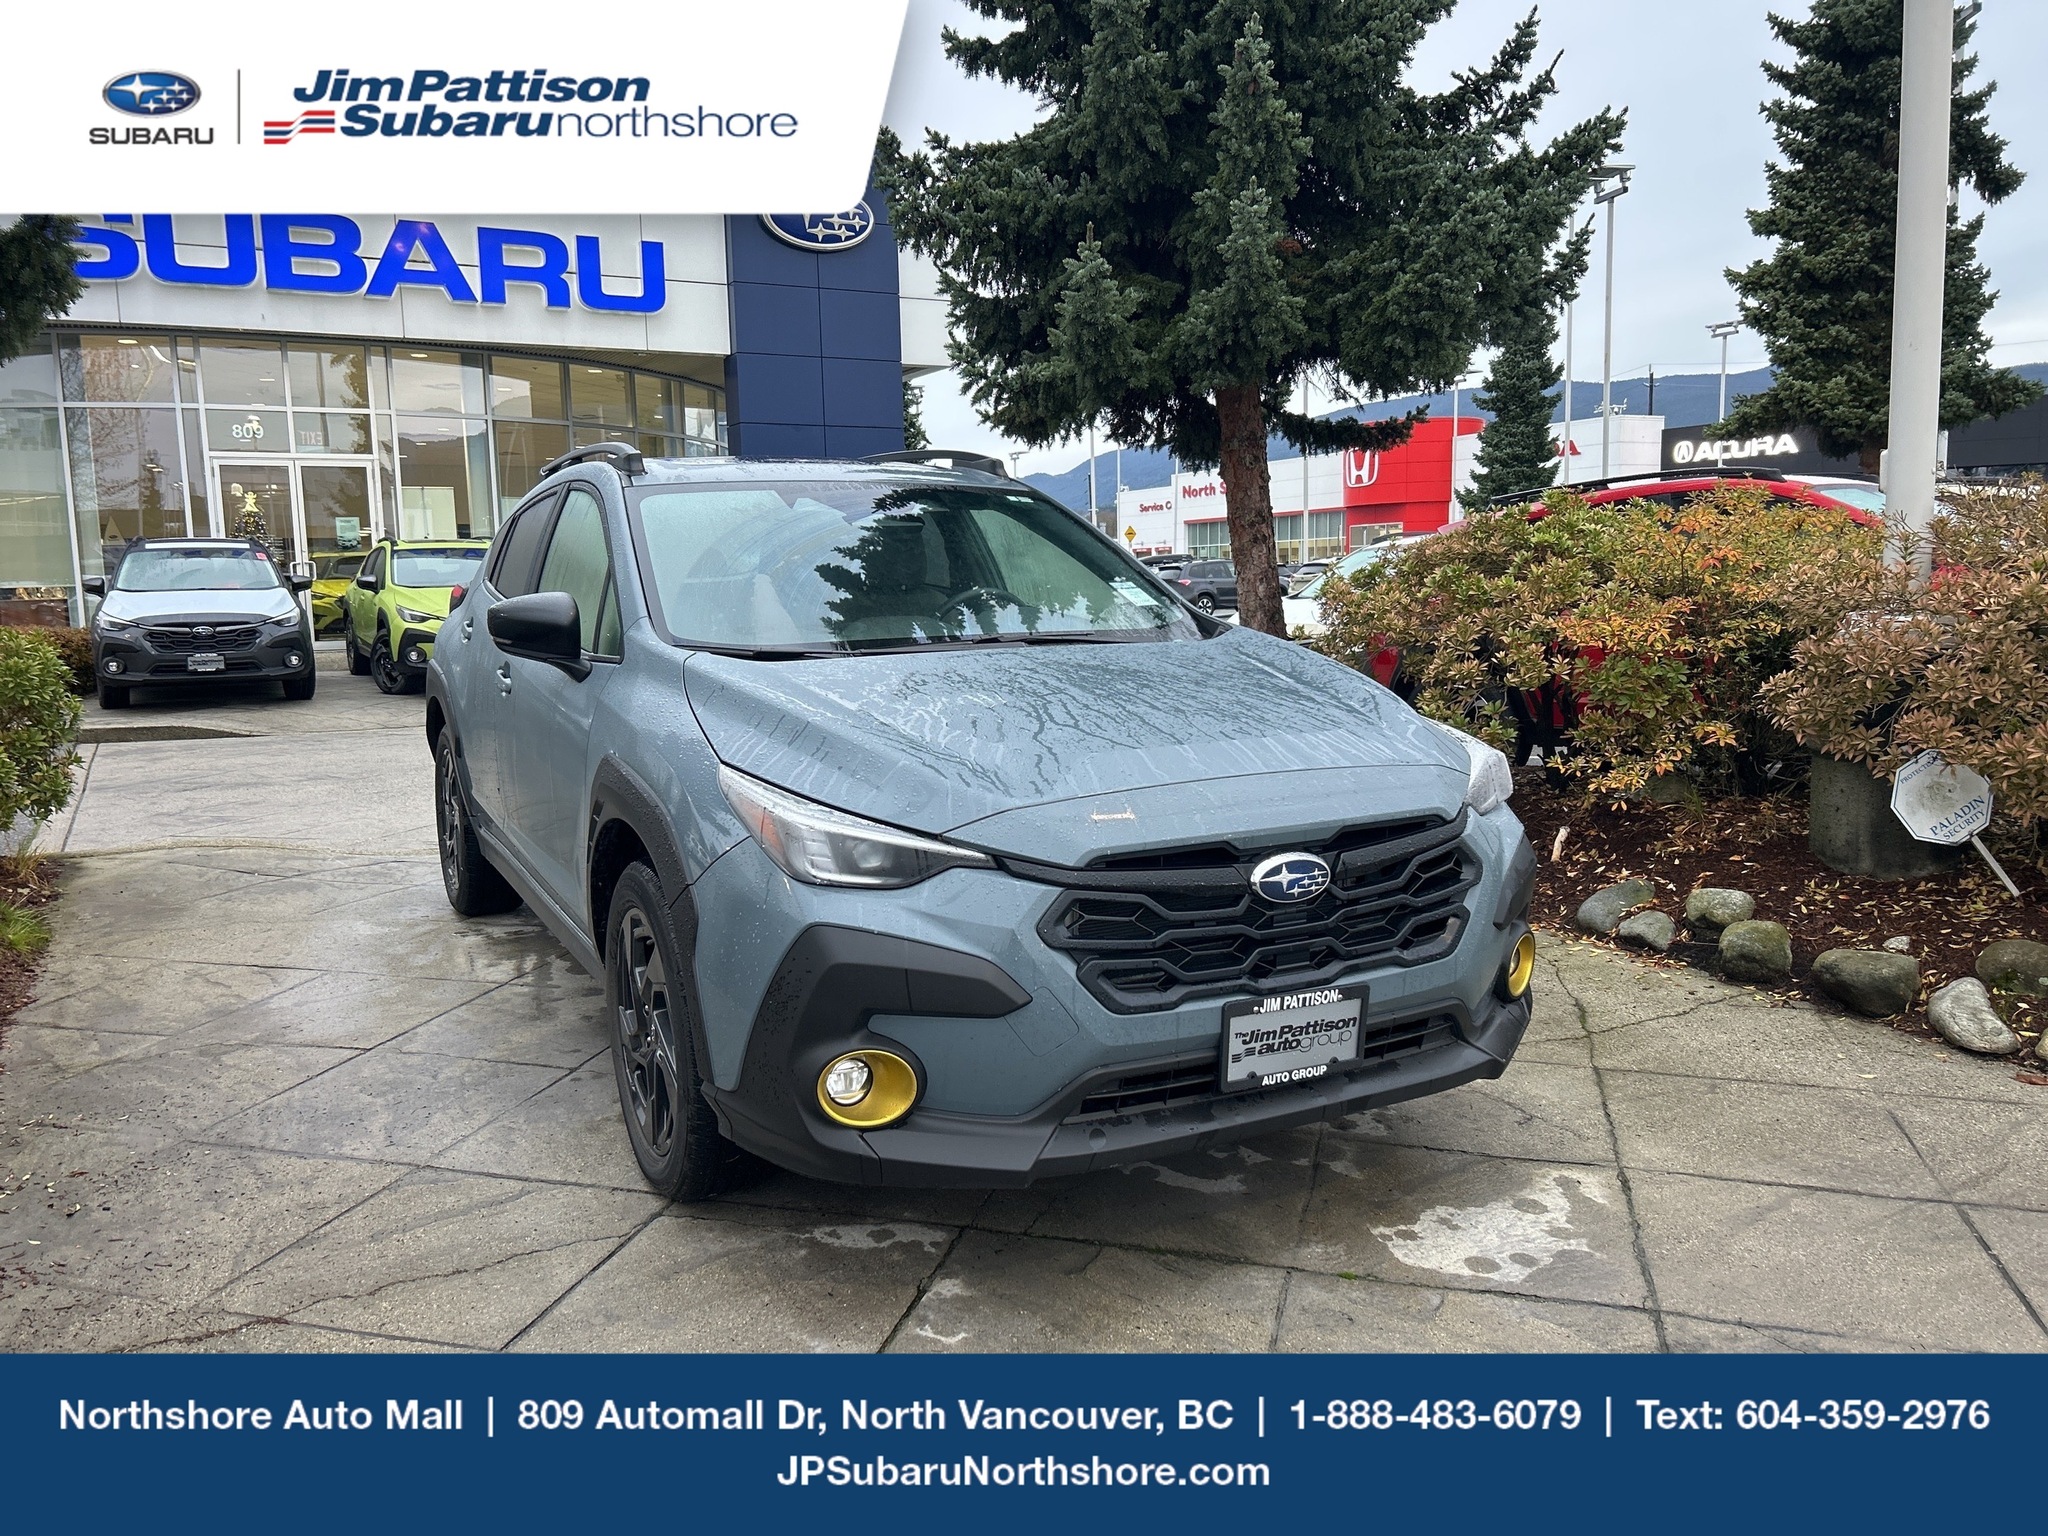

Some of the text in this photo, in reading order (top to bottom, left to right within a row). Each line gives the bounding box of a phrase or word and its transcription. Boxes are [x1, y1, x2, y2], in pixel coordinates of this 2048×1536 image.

[232, 424, 264, 438] 809
[1691, 434, 1799, 462] ACURA
[1182, 483, 1216, 498] North
[1139, 501, 1164, 512] Service
[1929, 795, 1986, 836] PALADIN
[1943, 808, 1986, 840] SECURITY
[1260, 989, 1339, 1013] JIM PATTISON
[1234, 1016, 1358, 1045] The Jim Pattison
[1262, 1065, 1328, 1086] AUTO GROUP
